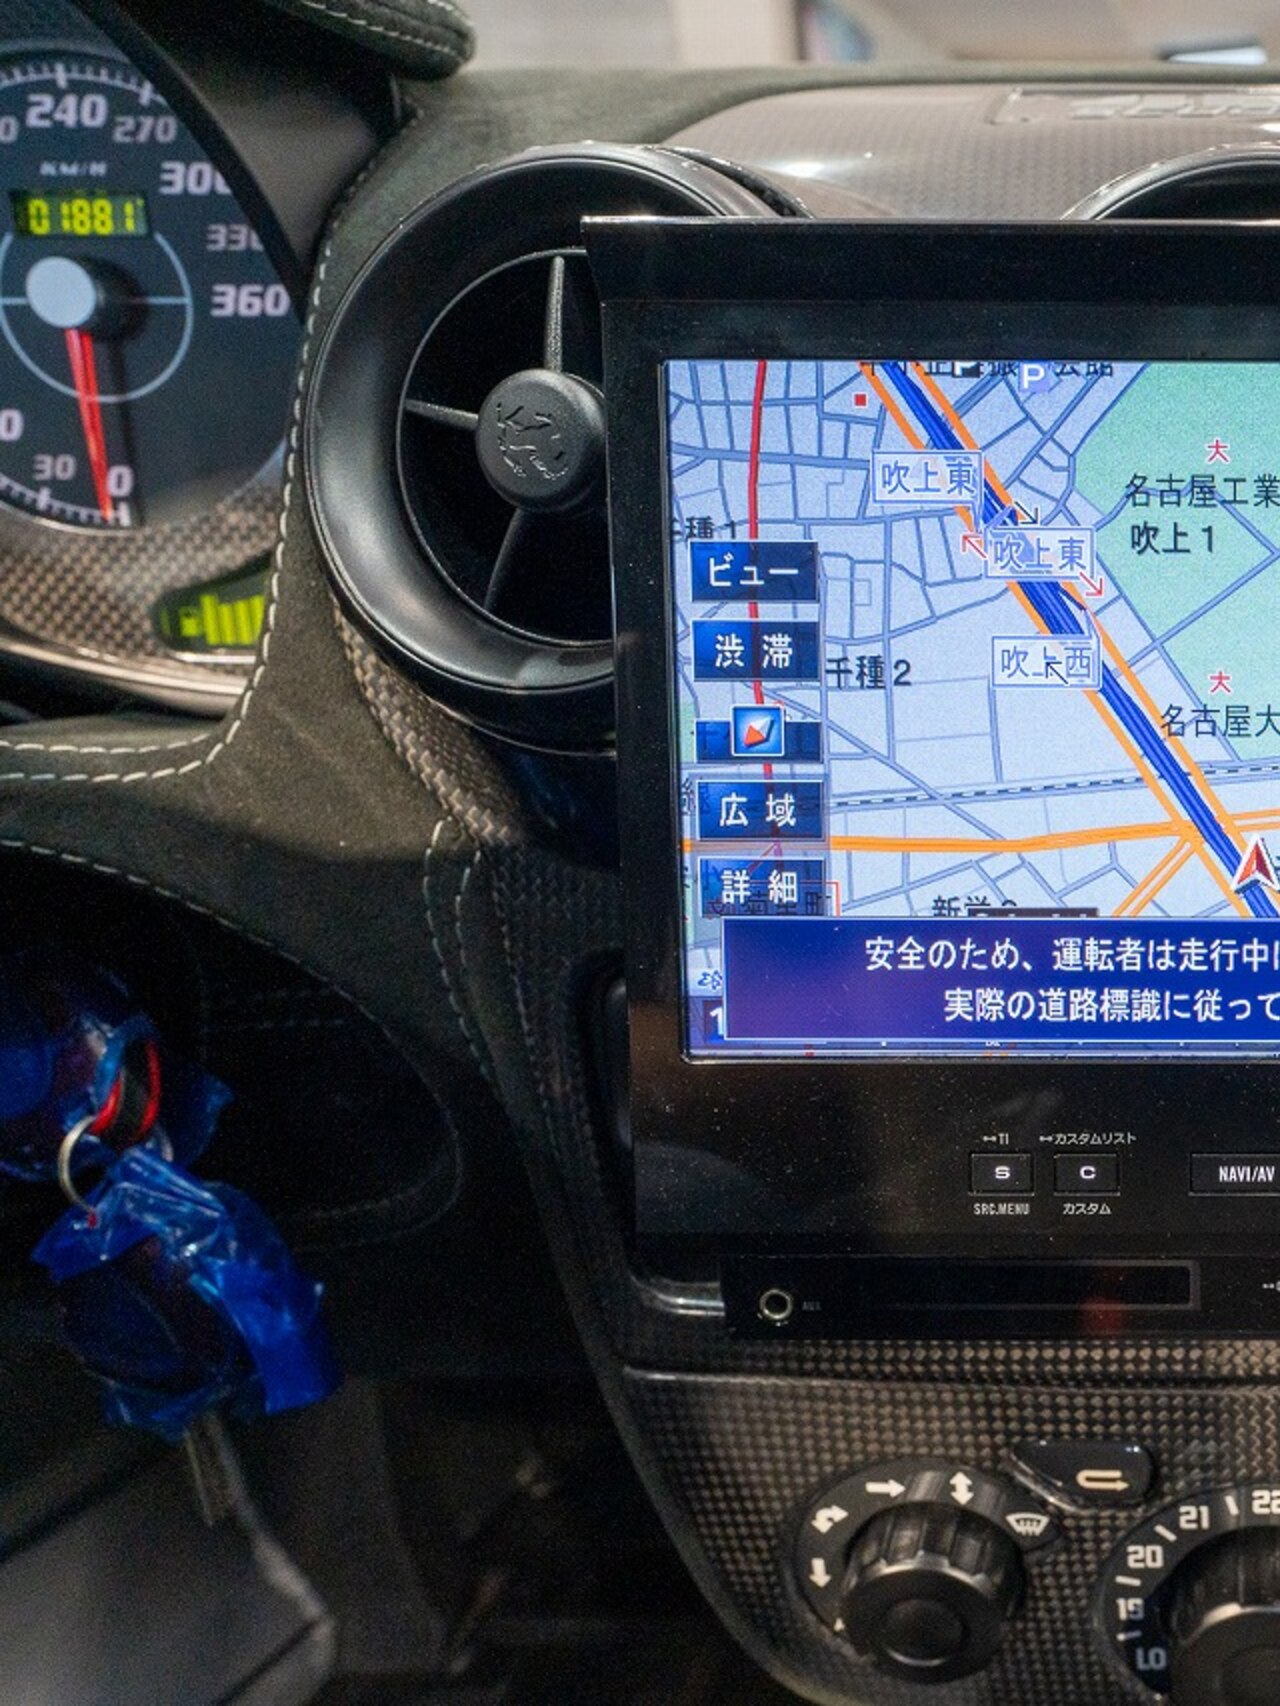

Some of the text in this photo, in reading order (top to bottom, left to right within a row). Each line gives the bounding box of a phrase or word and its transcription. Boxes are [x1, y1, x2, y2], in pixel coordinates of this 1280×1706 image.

[26, 93, 108, 128] 240
[113, 115, 177, 143] 270
[28, 198, 135, 235] 01881
[210, 284, 291, 317] 360
[33, 453, 77, 481] 30
[107, 465, 134, 497] 0
[881, 460, 977, 494] 吹上東
[994, 535, 1087, 571] 吹上東
[1131, 521, 1215, 555] 吹上1
[709, 552, 799, 587] ビュー
[825, 655, 913, 690] 千種2
[1001, 645, 1092, 679] 吹上西
[1055, 1132, 1137, 1145] カスタムリスト
[995, 1165, 1011, 1179] S
[1080, 1165, 1096, 1179] C
[1219, 1165, 1275, 1183] NAVI/AV
[1063, 1203, 1112, 1215] カスタム
[1178, 1505, 1209, 1530] 21
[1126, 1545, 1163, 1568] 20
[1136, 1647, 1167, 1671] LO
